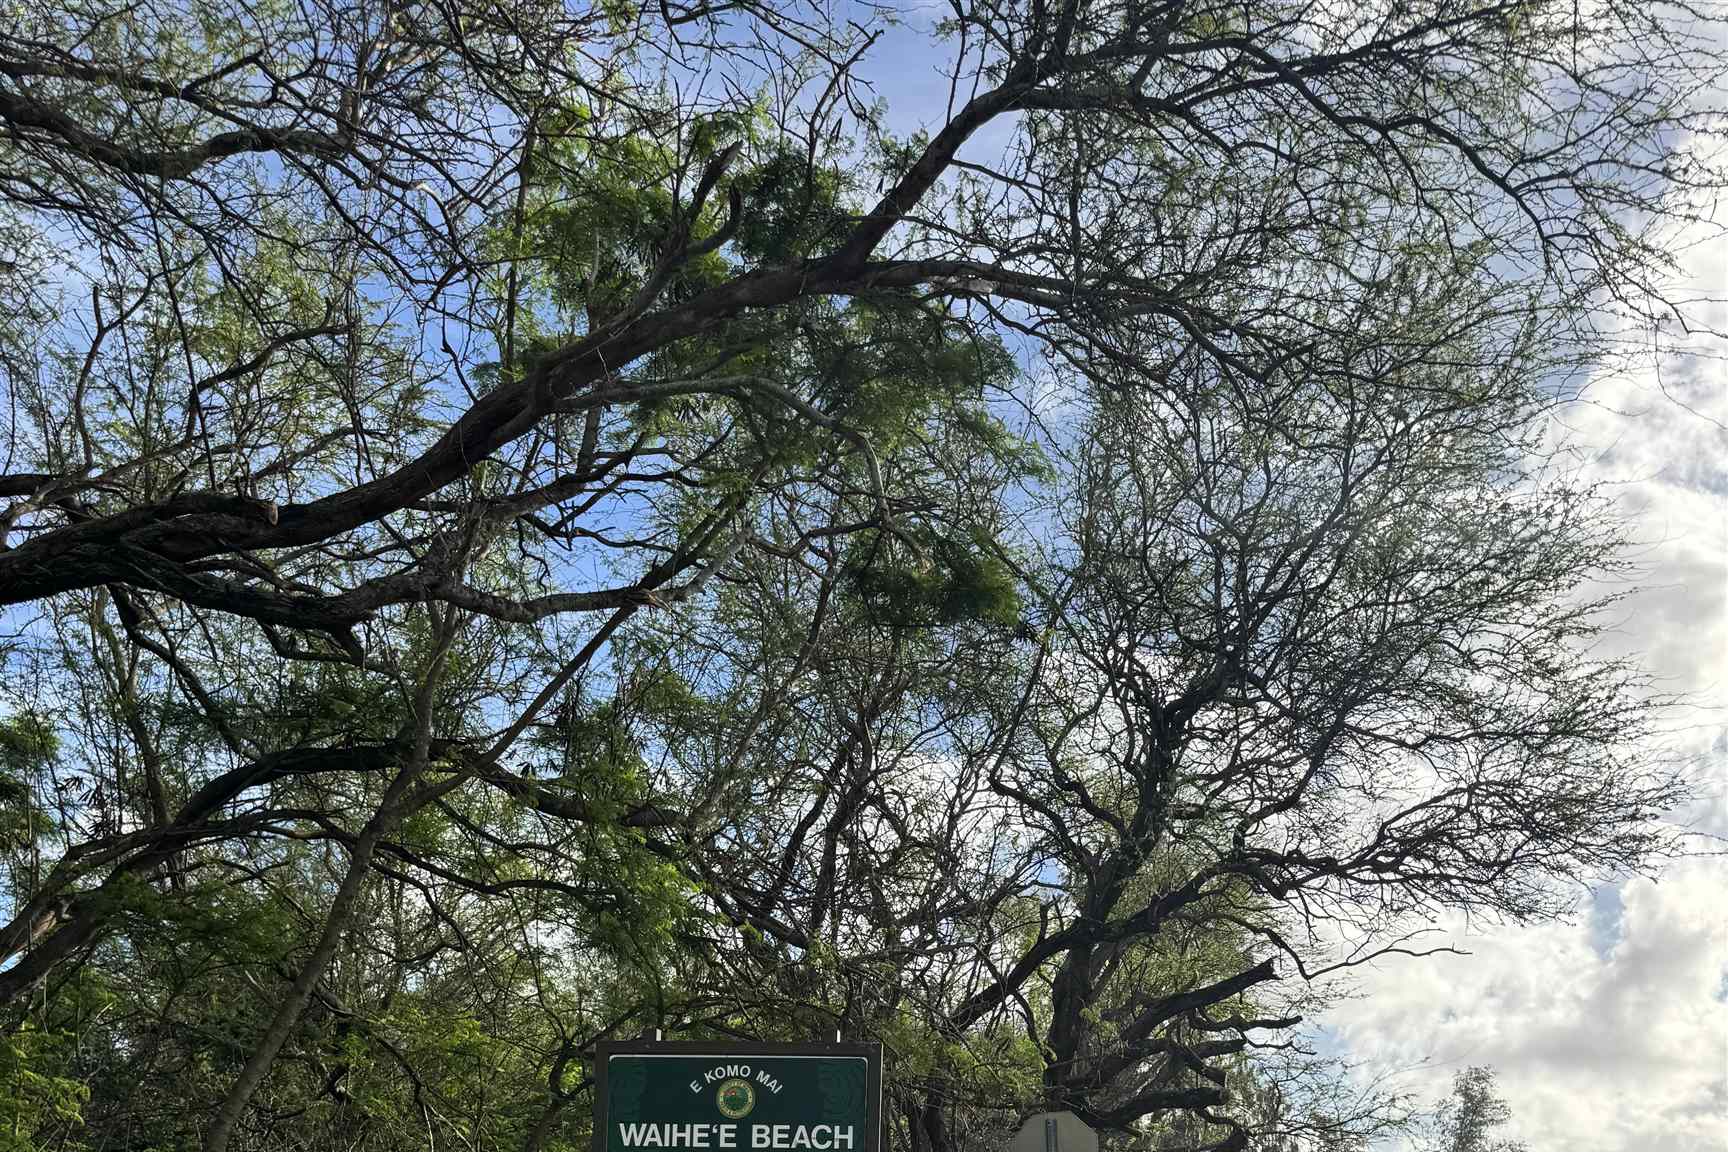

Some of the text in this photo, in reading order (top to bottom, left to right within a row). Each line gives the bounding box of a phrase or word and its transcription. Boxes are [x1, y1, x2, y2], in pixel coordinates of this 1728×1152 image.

[689, 1065, 783, 1094] E KOMO MAI
[752, 1125, 854, 1149] BEACH
